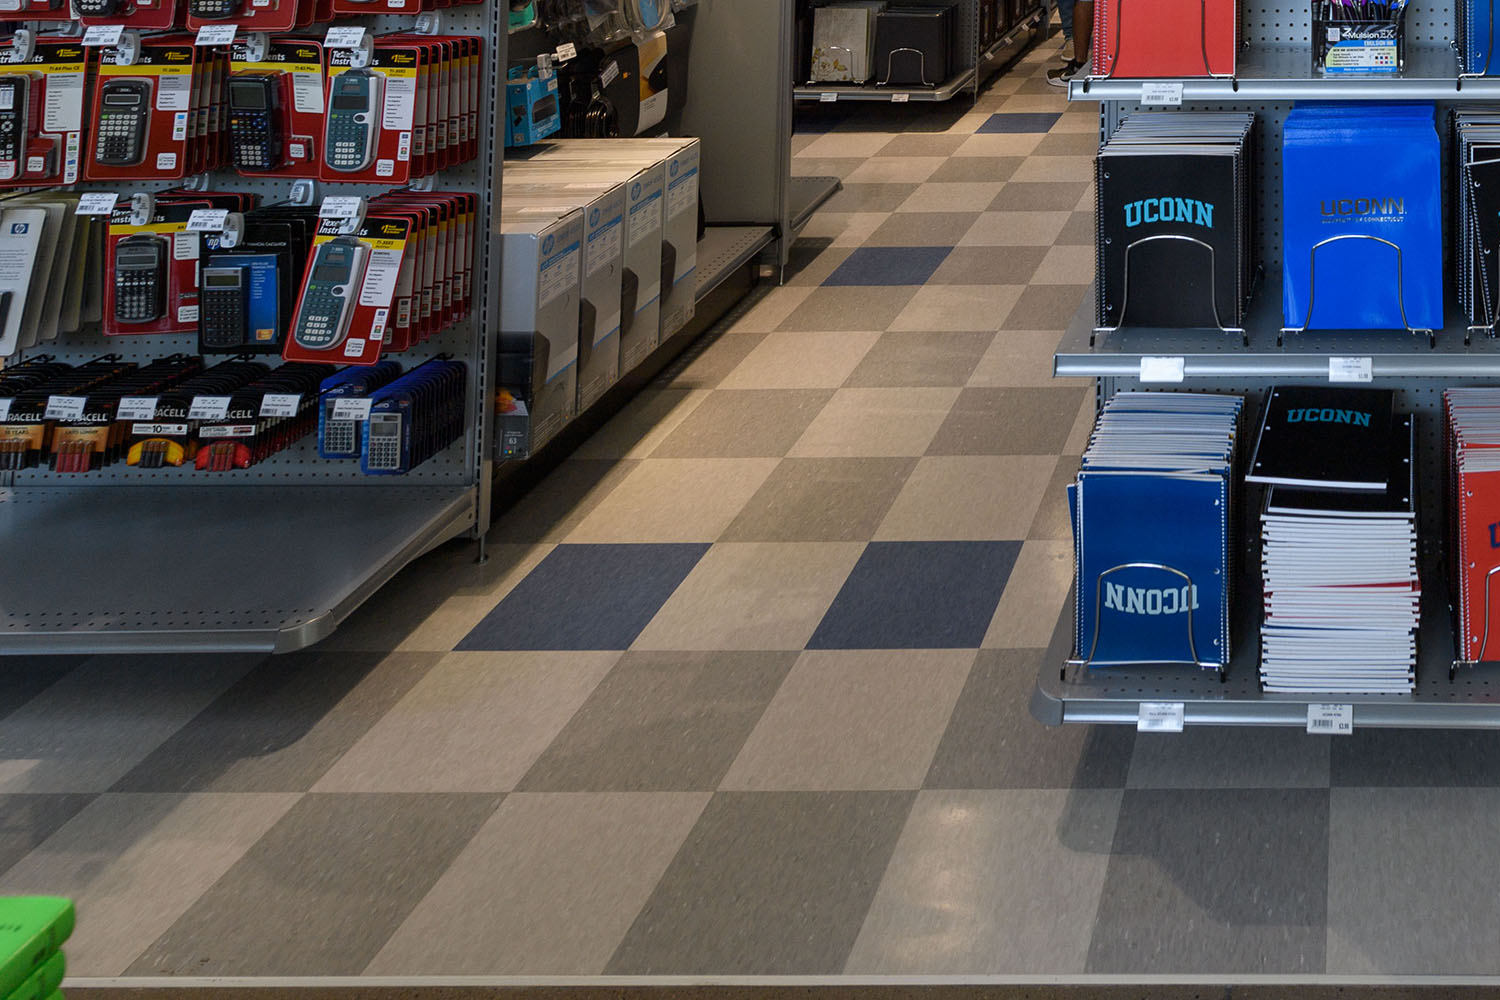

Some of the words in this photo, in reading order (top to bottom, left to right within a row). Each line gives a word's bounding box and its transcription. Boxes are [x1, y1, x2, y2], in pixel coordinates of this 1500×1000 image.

[1320, 197, 1405, 217] UCONN
[1124, 197, 1215, 229] UCONN
[207, 238, 219, 249] hp
[7, 413, 42, 422] RACELL
[153, 408, 186, 418] RACELL
[225, 409, 253, 419] ACELL
[1287, 408, 1372, 427] UCONN
[152, 425, 162, 433] 10
[508, 437, 517, 445] 63
[1105, 581, 1200, 616] UCONN
